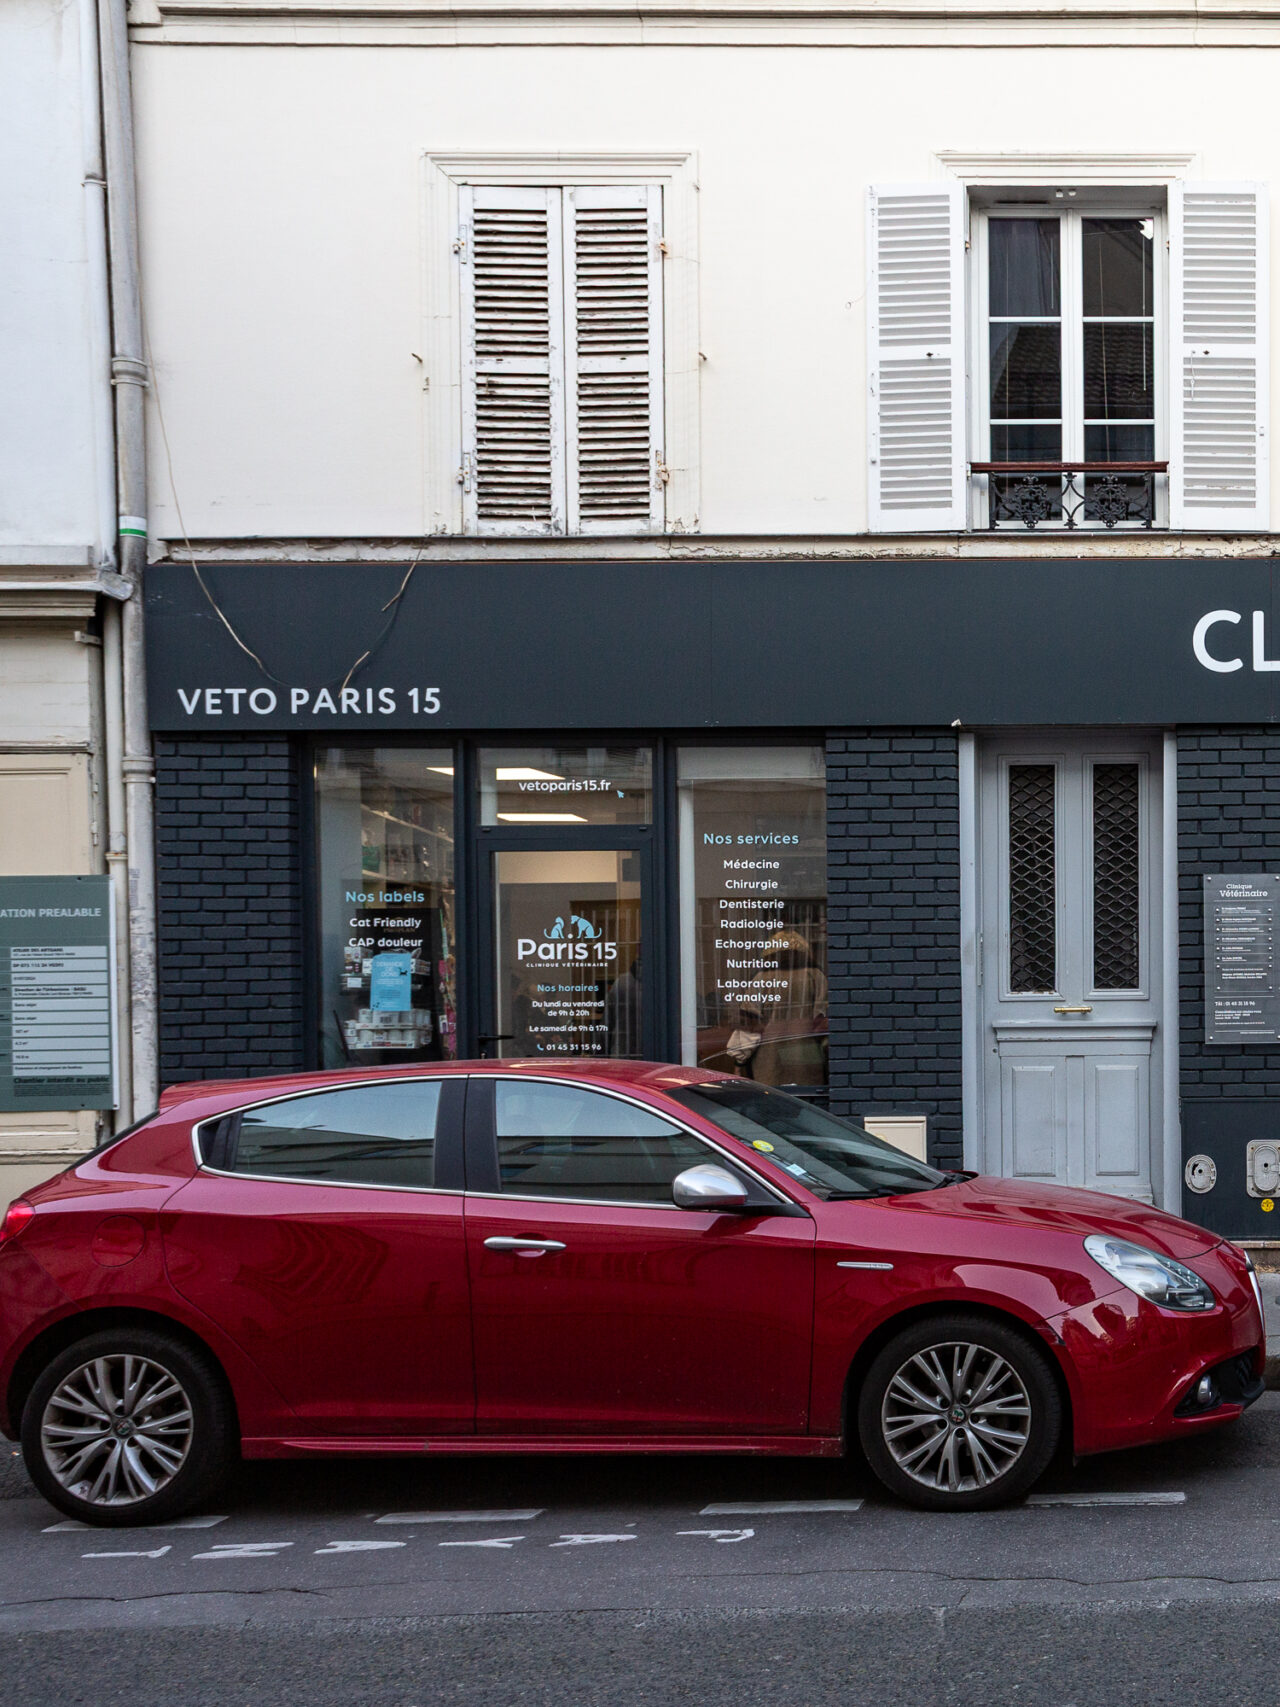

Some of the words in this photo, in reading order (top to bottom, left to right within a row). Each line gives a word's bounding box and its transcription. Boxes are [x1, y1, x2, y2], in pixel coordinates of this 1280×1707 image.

[178, 687, 278, 715] VETO
[290, 687, 397, 714] PARIS
[408, 687, 441, 714] 15
[518, 779, 611, 793] vetoparis15.fr
[704, 833, 732, 844] Nos
[737, 833, 800, 844] services
[724, 859, 780, 870] Médecine
[725, 878, 778, 891] Chirurgie
[346, 890, 374, 902] Nos
[379, 890, 424, 902] labels
[719, 899, 785, 910] Dentisterie
[38, 908, 102, 917] PREALABLE
[350, 918, 370, 928] Cat
[374, 917, 422, 929] Friendly
[720, 919, 784, 931] Radiologie
[349, 938, 374, 947] CAP
[378, 937, 424, 947] douleur
[518, 934, 590, 960] Paris
[593, 942, 618, 960] 15
[715, 938, 790, 951] Echographie
[726, 959, 778, 969] Nutrition
[558, 984, 599, 992] horaires
[717, 978, 788, 988] Laboratoire
[724, 992, 782, 1004] d'analyse
